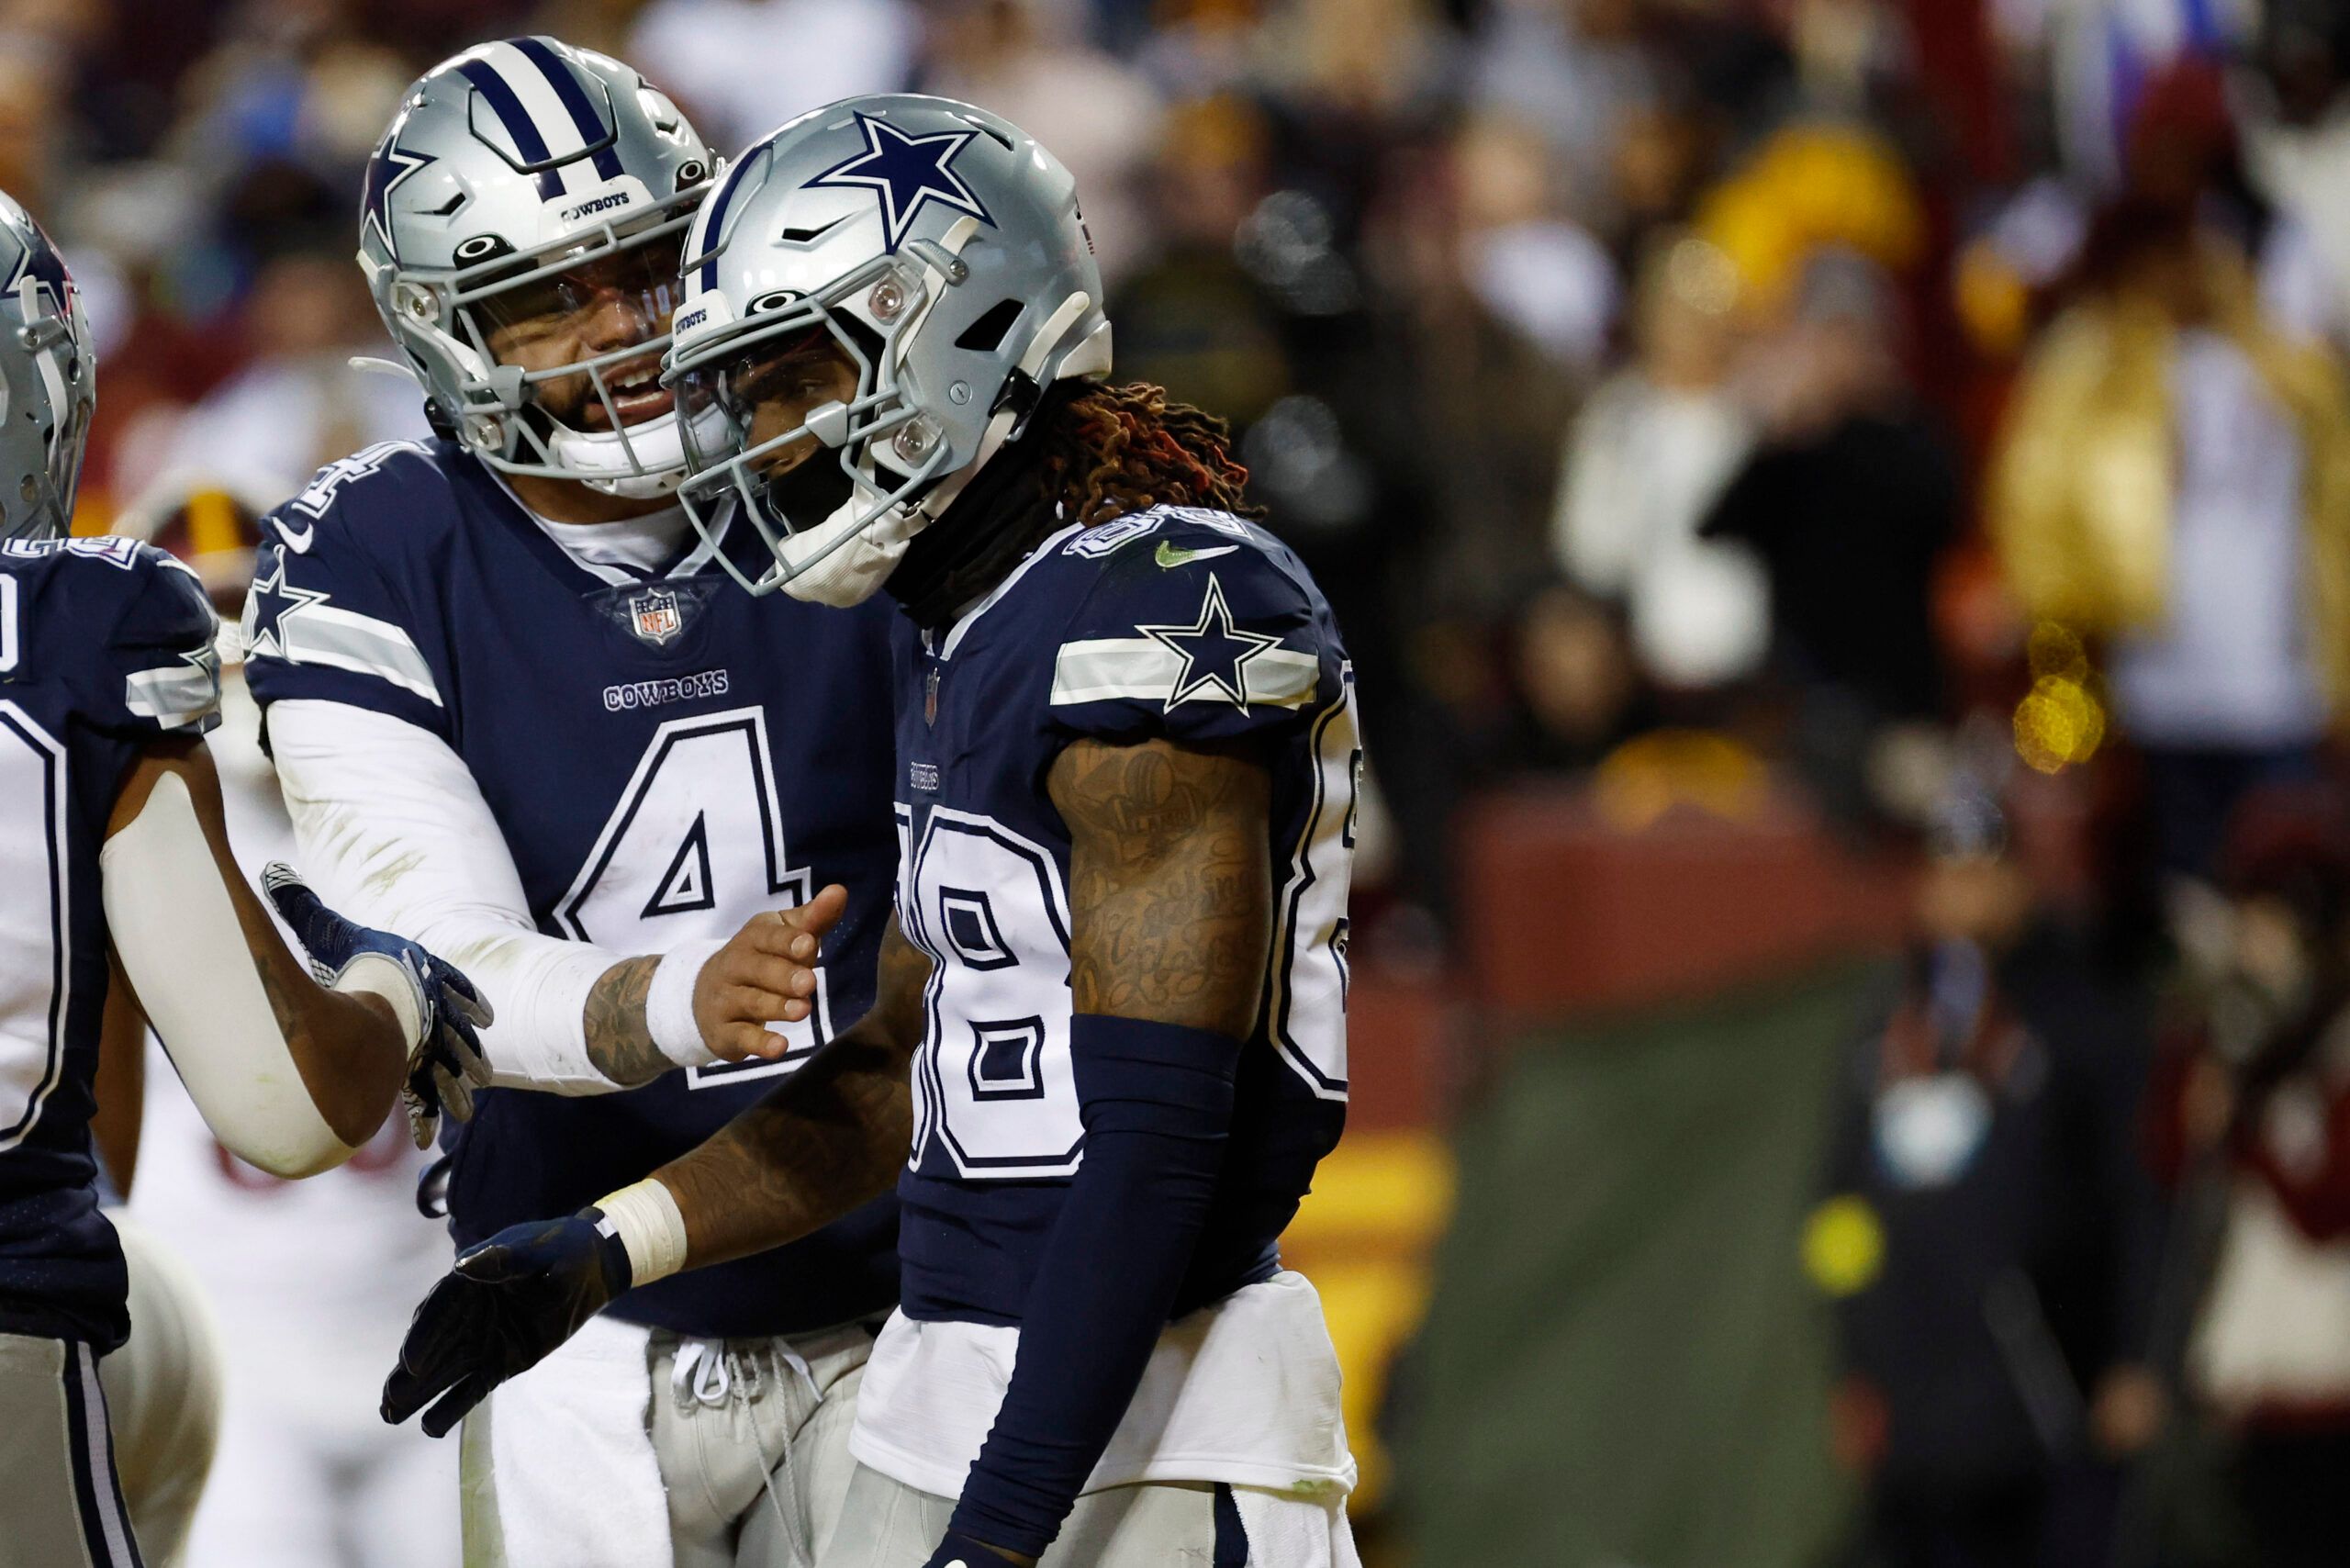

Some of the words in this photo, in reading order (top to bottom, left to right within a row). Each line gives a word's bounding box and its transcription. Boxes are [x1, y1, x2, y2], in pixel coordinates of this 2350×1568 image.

[561, 192, 630, 222] COWBOYS
[640, 610, 675, 633] NFL
[603, 669, 729, 711] COWBOYS
[552, 705, 834, 1091] 4
[894, 801, 1086, 1179] 8
